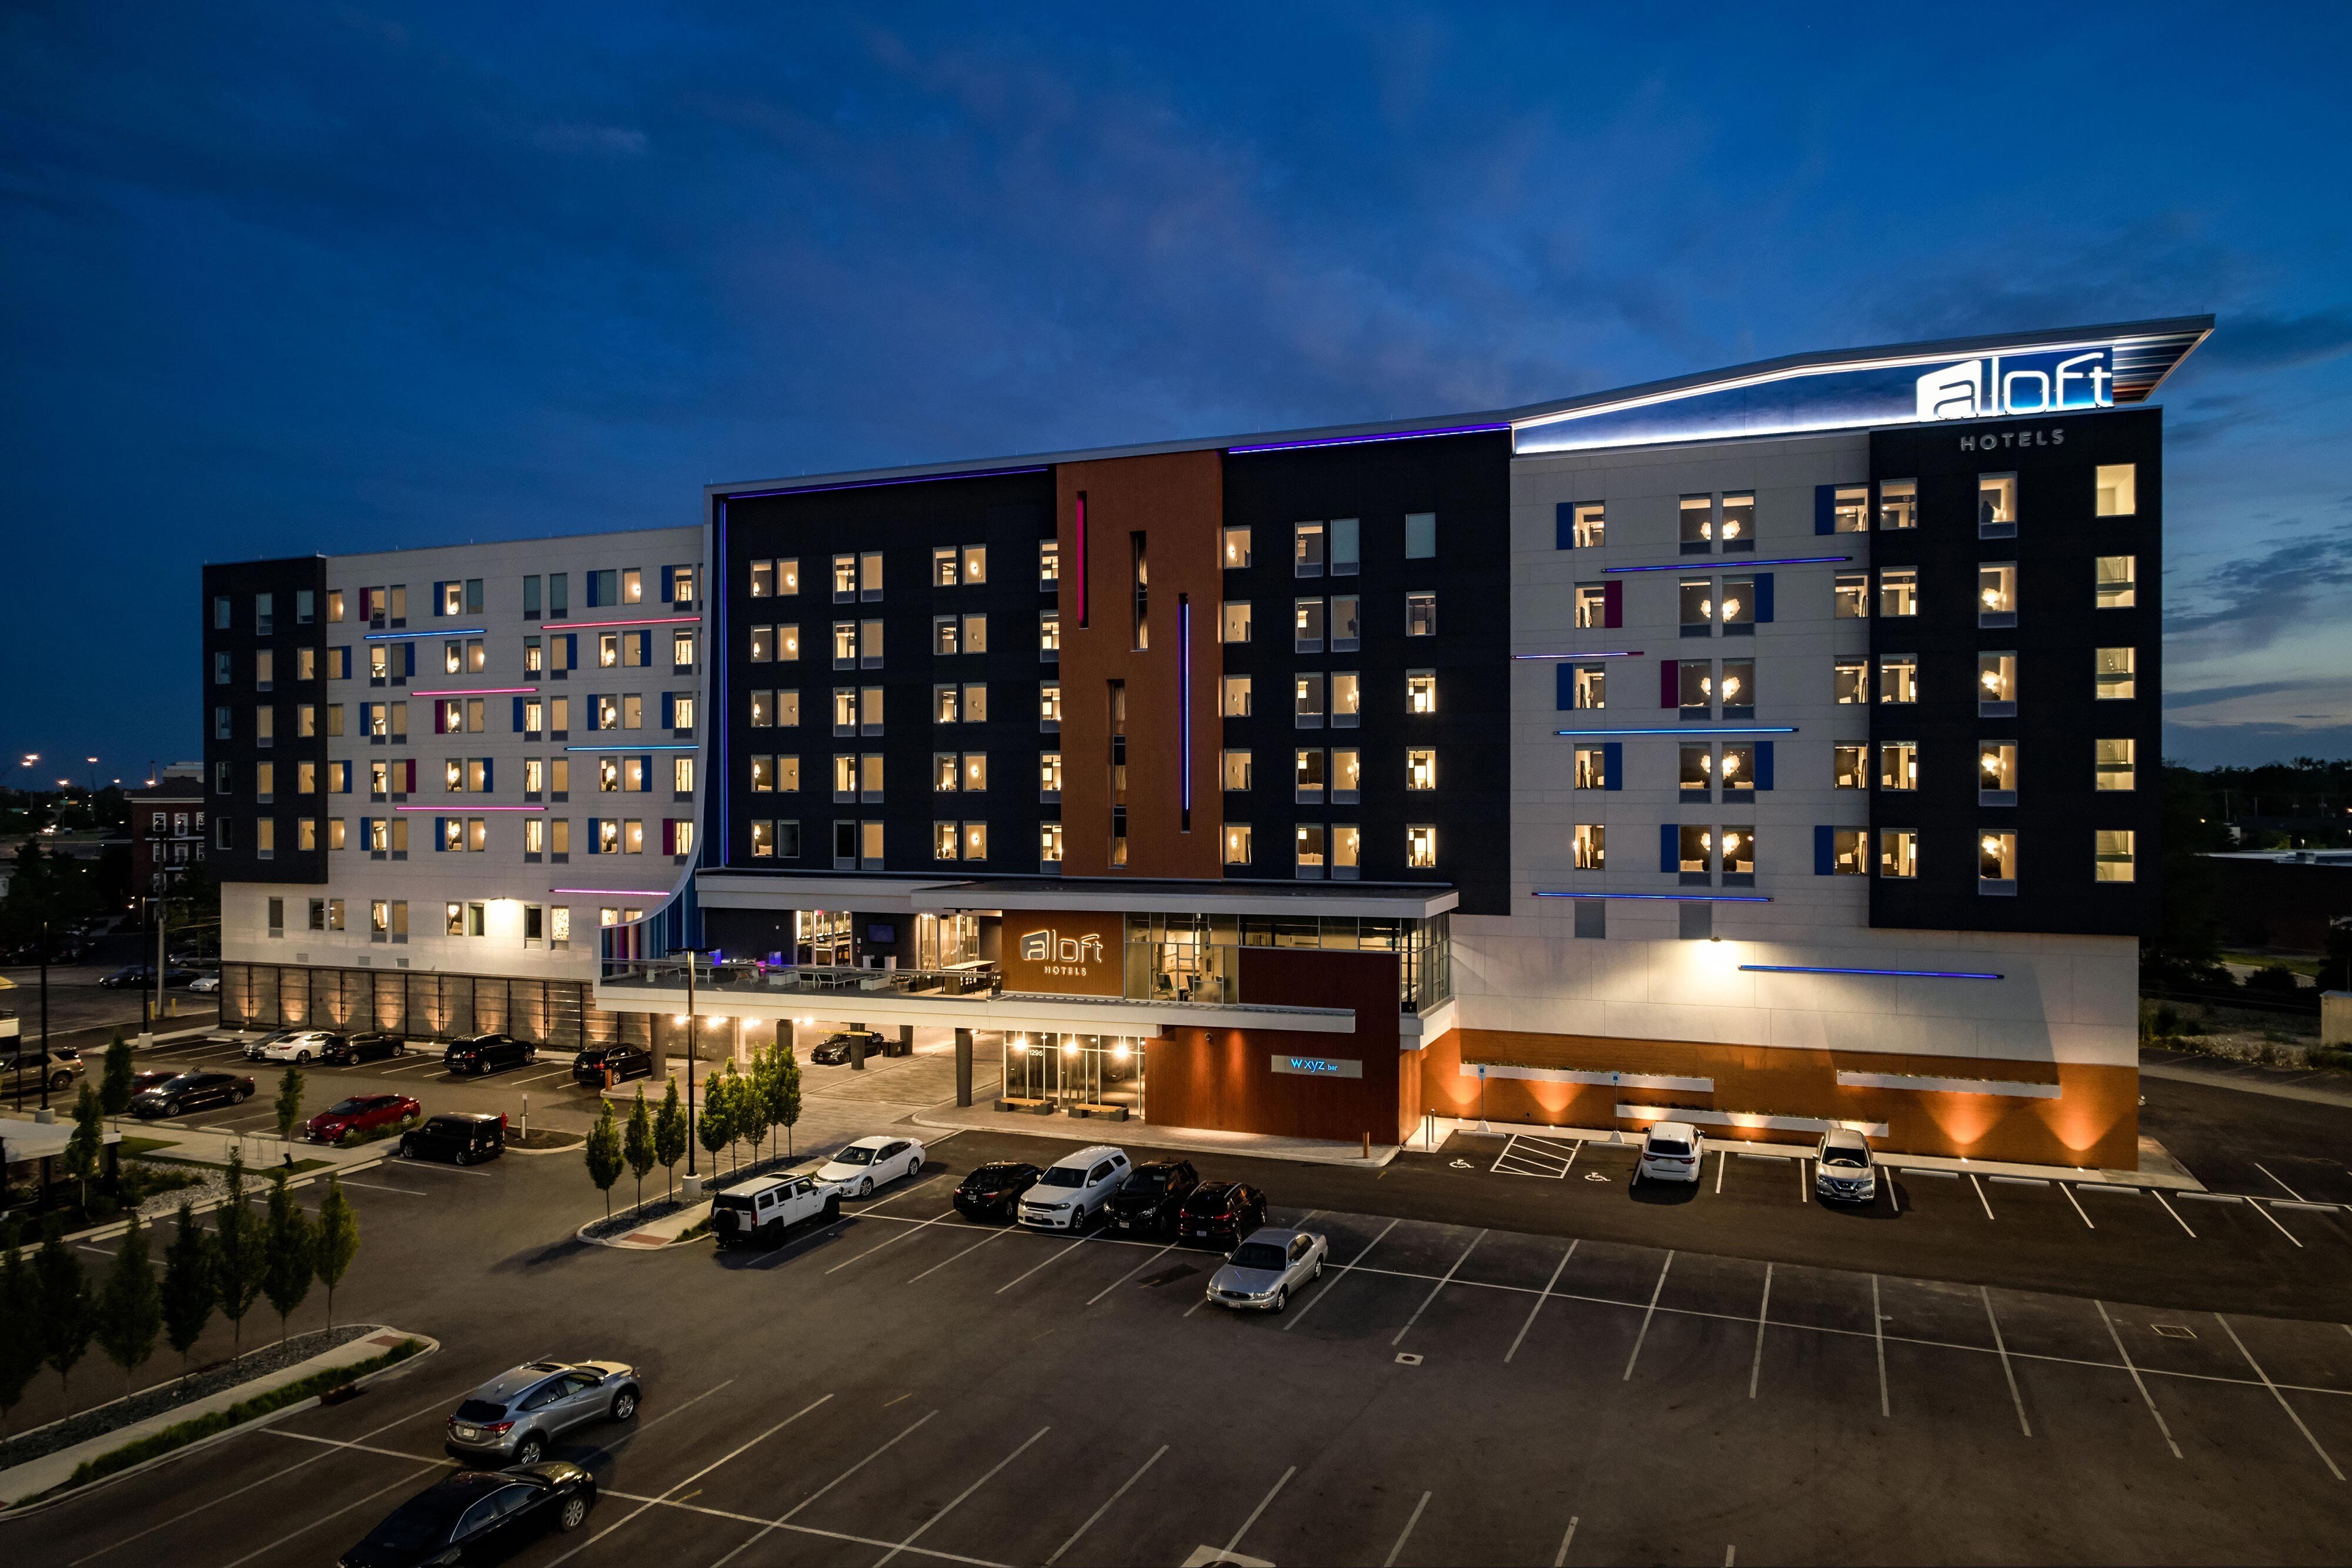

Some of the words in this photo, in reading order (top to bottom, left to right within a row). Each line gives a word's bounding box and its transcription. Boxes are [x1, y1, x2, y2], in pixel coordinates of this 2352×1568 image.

[1916, 352, 2115, 422] aloft
[1960, 429, 2064, 451] HOTELS
[1020, 930, 1103, 963] aloft
[1044, 966, 1087, 976] HOTELS
